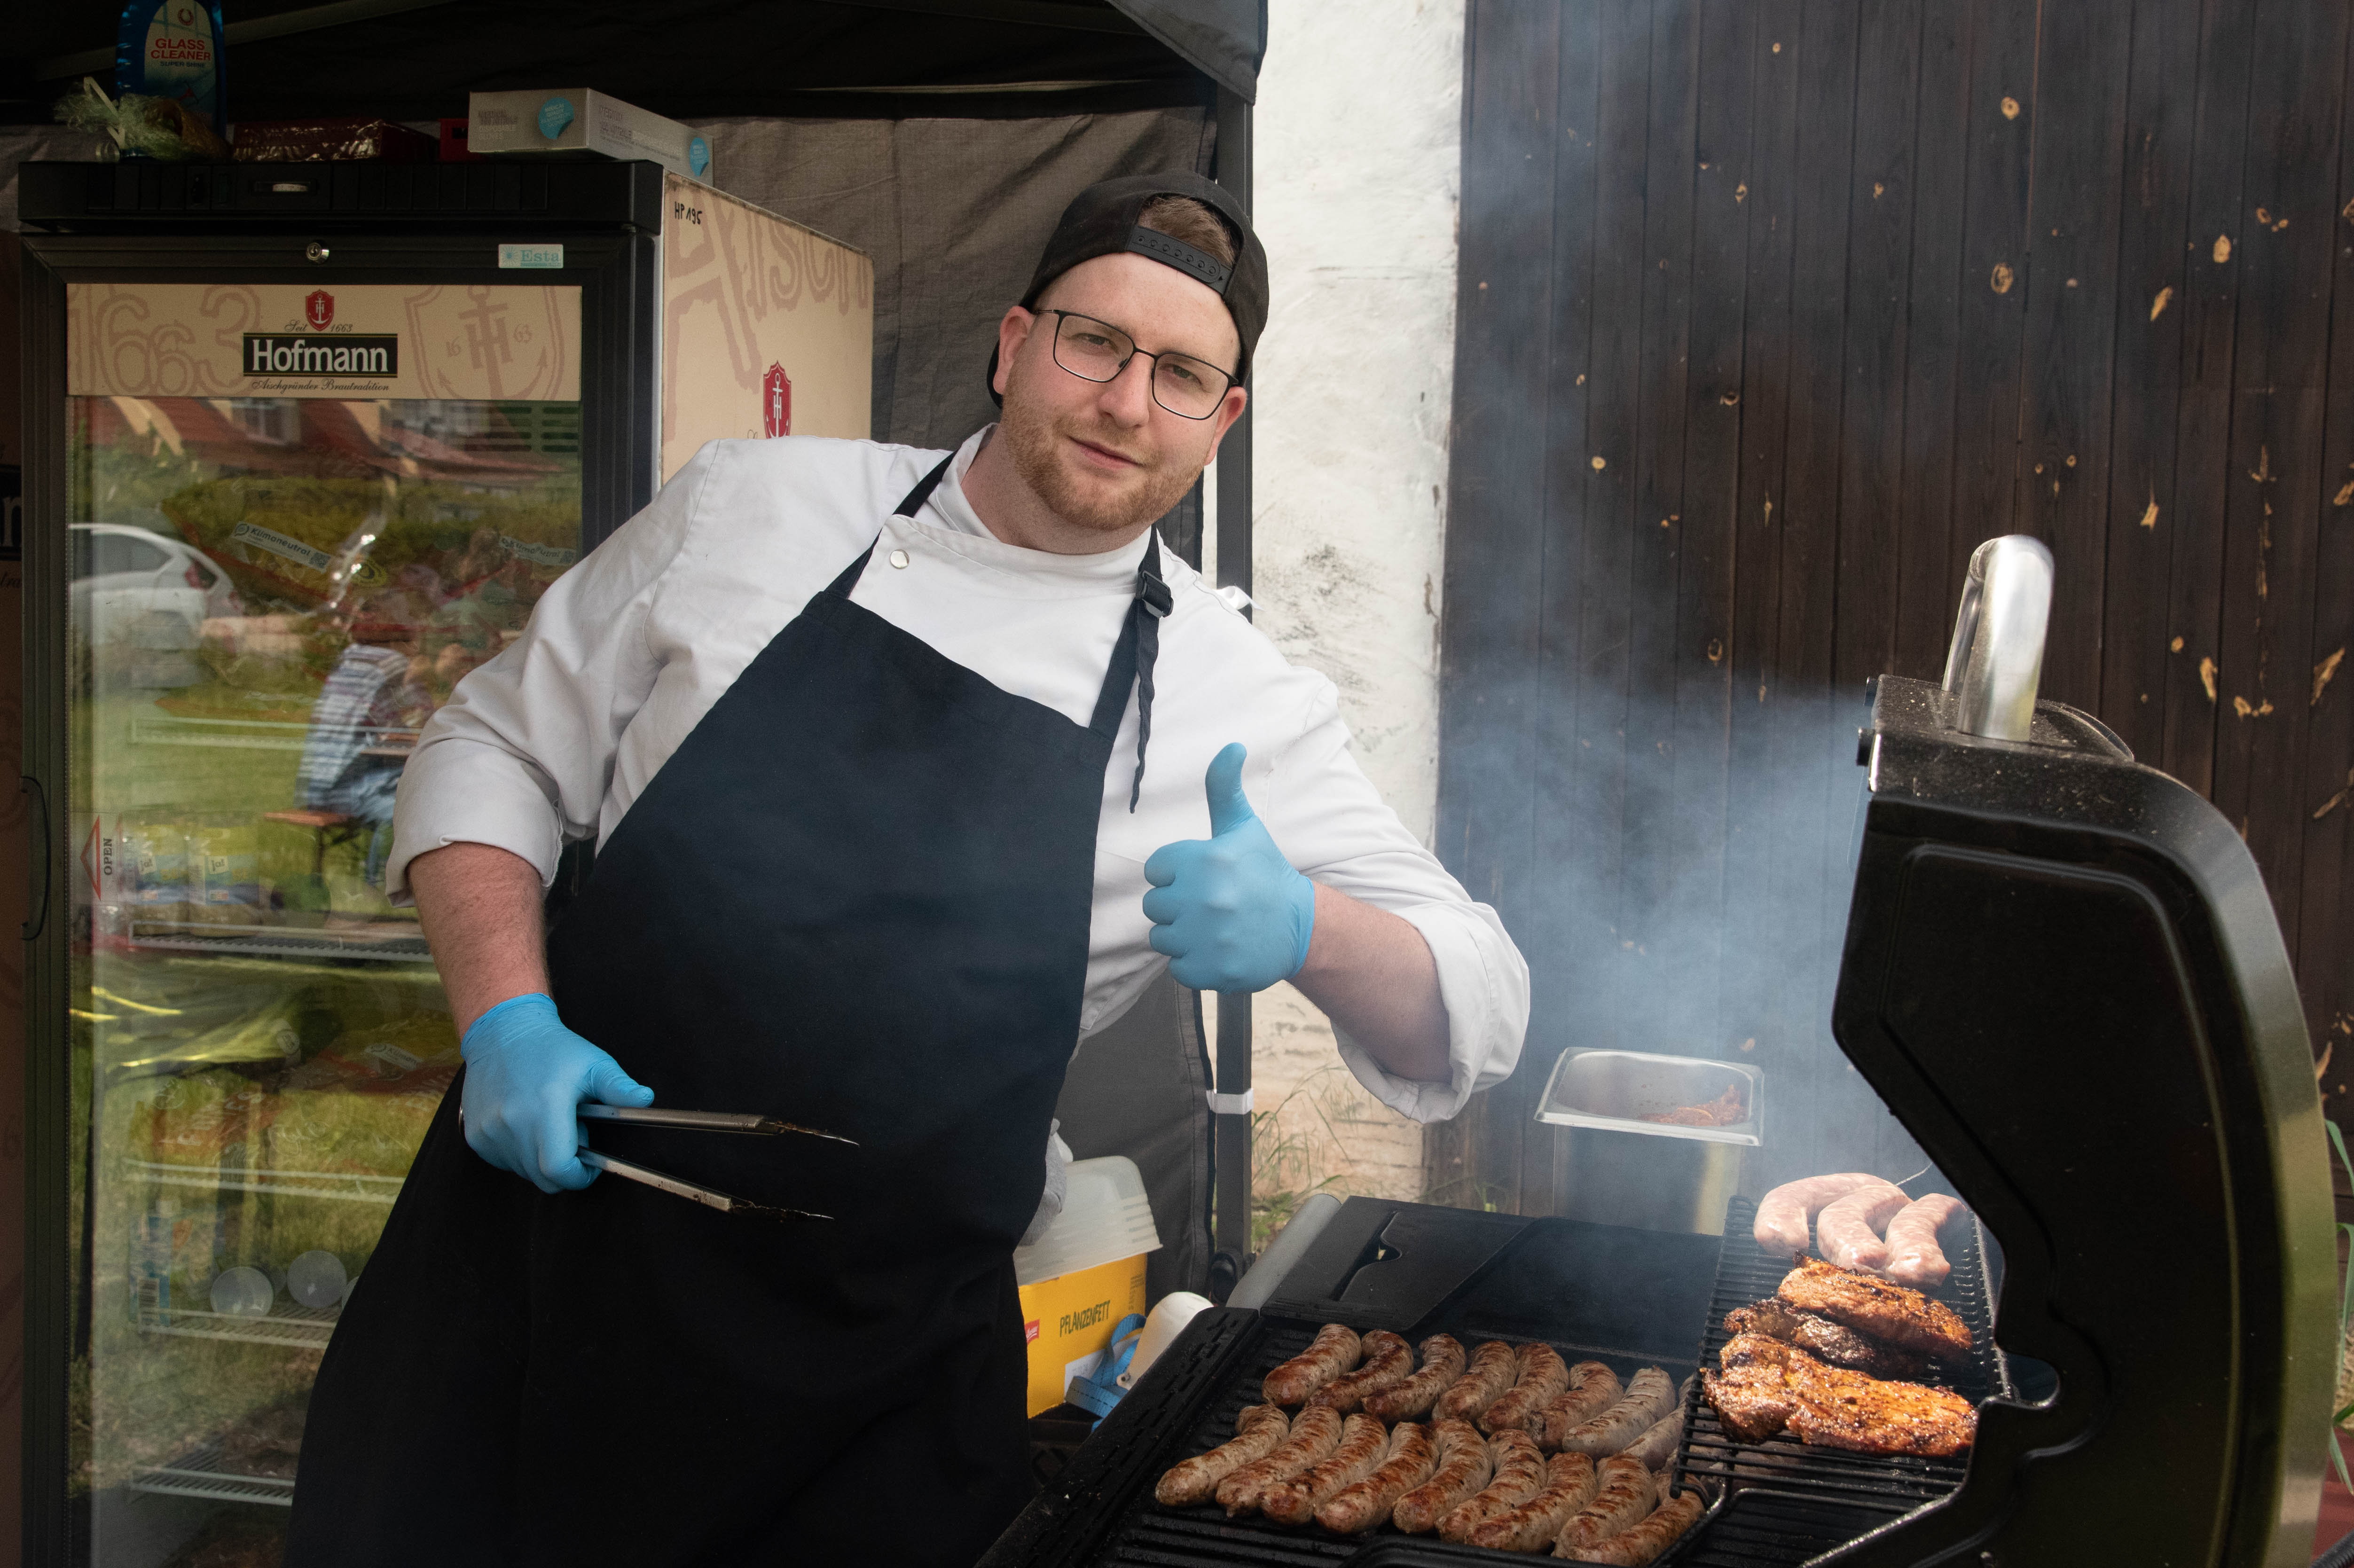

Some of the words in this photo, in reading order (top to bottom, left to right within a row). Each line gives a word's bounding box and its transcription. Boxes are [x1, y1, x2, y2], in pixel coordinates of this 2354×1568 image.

[155, 38, 205, 50] GLASS
[150, 49, 211, 61] CLEANER
[675, 201, 685, 220] HP
[686, 207, 702, 225] 195
[520, 250, 559, 262] Esta
[284, 319, 308, 332] Seit
[330, 323, 353, 332] 1663
[252, 339, 389, 372] Hofmann
[252, 378, 319, 394] Aischgründer
[321, 378, 389, 391] Brautradition
[251, 527, 311, 556] Klimaneutral
[103, 838, 112, 876] OPEN
[1059, 1299, 1111, 1338] PFLANZENFETT
